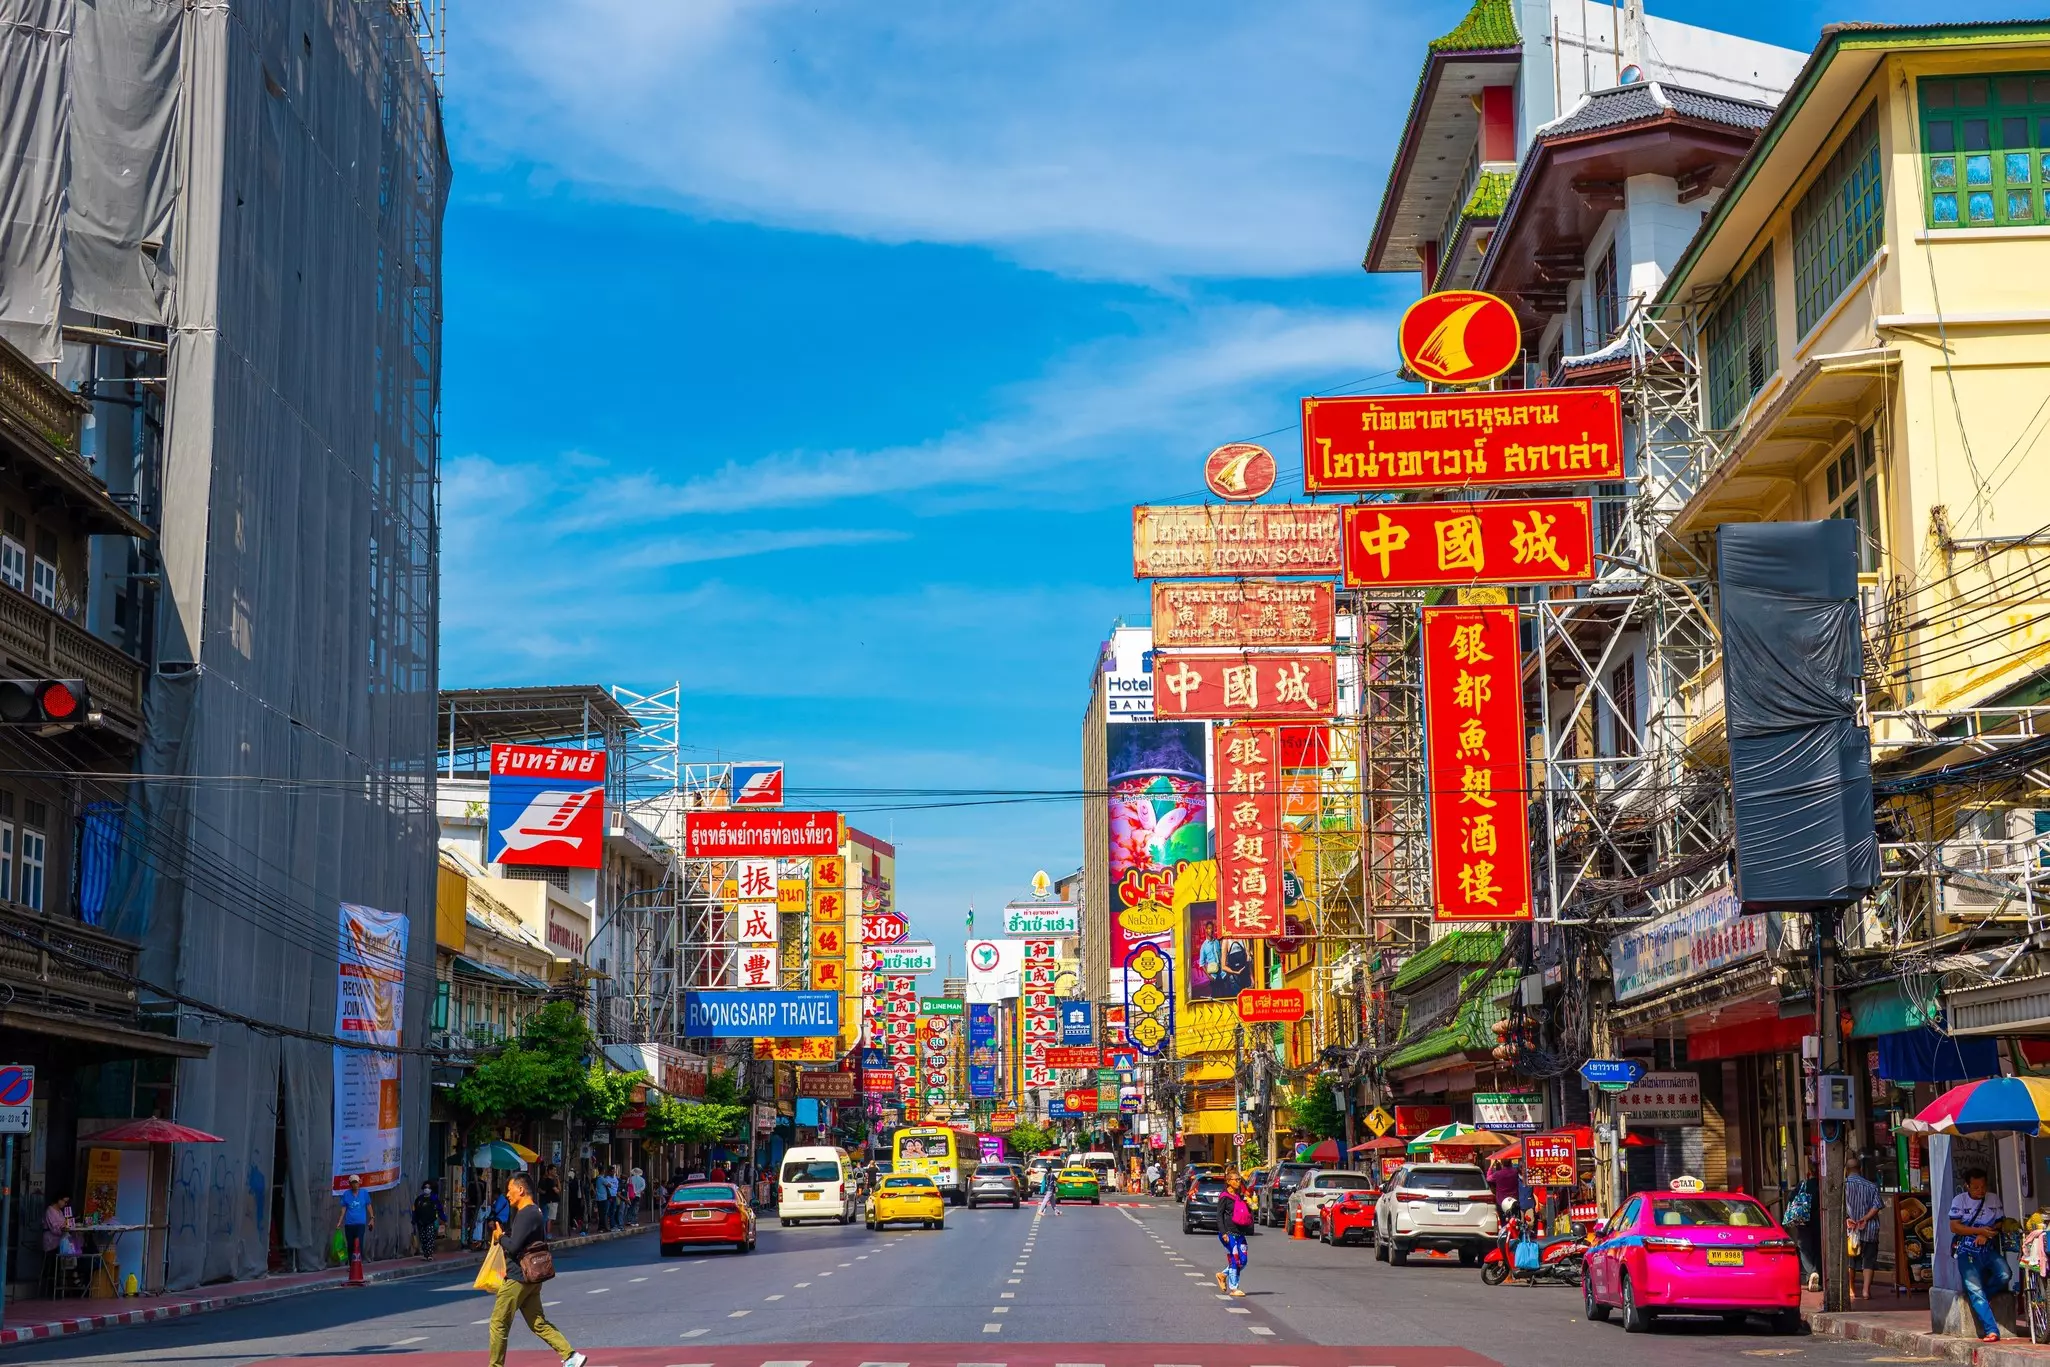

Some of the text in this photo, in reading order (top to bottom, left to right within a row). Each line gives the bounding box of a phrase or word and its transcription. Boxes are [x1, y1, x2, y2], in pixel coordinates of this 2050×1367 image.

[1361, 403, 1560, 433] ภัตตาคารหูฉลาม
[1316, 432, 1609, 478] ไชน่าทาวน์ สกาล่า
[1359, 510, 1570, 579] 中國城
[1149, 547, 1338, 567] CHINA TOWN SCALA
[1289, 627, 1318, 639] NEST
[1108, 677, 1152, 692] Hotel
[1165, 660, 1319, 713] 中國城
[1109, 700, 1154, 710] BAN
[496, 747, 600, 775] รุ่งทรัพย์
[1447, 624, 1503, 907] 銀都魚翅酒樓
[691, 813, 833, 855] รุ่งทรัพย์การท่องเที่ยว
[1224, 737, 1273, 930] 銀都魚翅酒樓
[1127, 914, 1166, 926] NaRaYa
[690, 1001, 834, 1027] ROONGSARP TRAVEL
[1589, 1063, 1636, 1076] เยาวราช 2
[8, 1114, 14, 1123] 23
[1530, 1144, 1569, 1157] เกาลัด
[1680, 1180, 1695, 1188] TAXI
[1724, 1251, 1741, 1259] 9988
